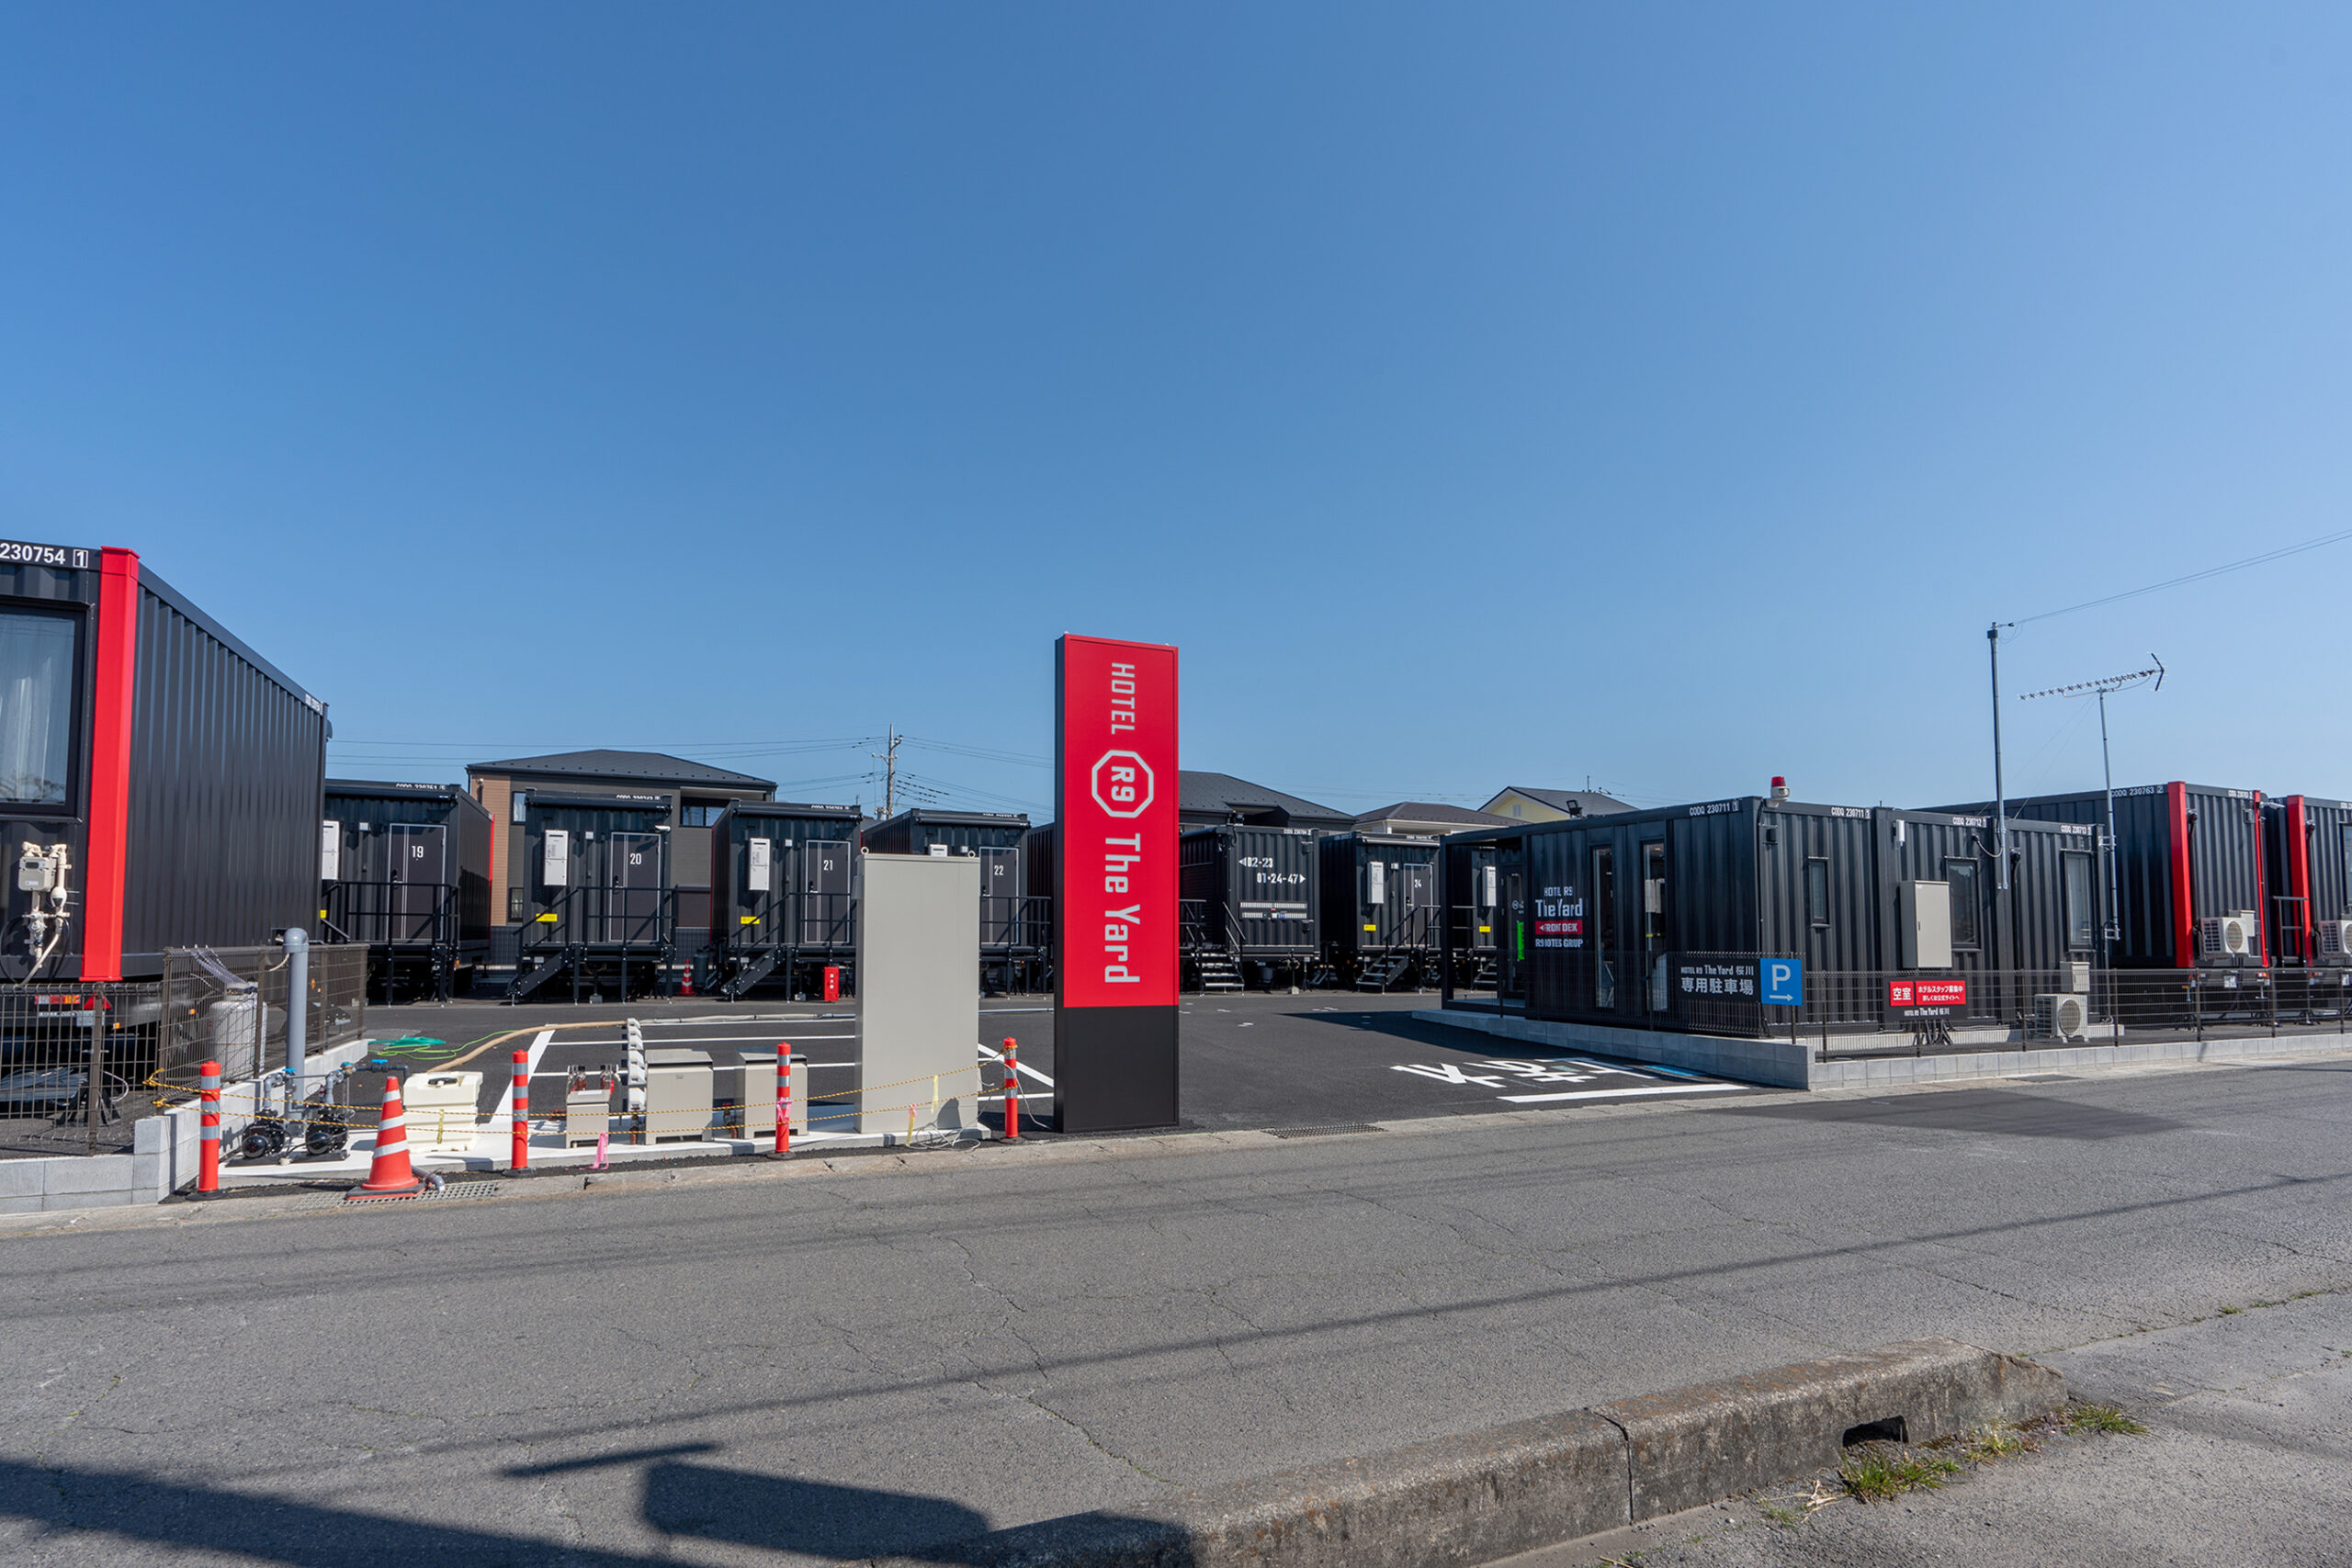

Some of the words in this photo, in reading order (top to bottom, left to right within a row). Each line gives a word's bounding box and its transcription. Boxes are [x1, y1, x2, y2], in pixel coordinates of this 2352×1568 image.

[0, 542, 65, 565] 230754
[74, 549, 88, 568] 1
[1111, 661, 1136, 735] HOTEL
[1111, 765, 1136, 802] R9
[1706, 802, 1730, 814] 230711
[412, 845, 424, 858] 19
[629, 852, 642, 865] 20
[823, 860, 833, 871] 21
[994, 865, 1004, 875] 22
[1104, 832, 1141, 894] The
[1556, 897, 1583, 917] Yard
[1104, 903, 1141, 984] Yard
[1703, 964, 1717, 975] The
[1717, 964, 1734, 976] Yard
[1770, 964, 1792, 991] P
[1680, 976, 1754, 996] 専用駐車場
[1893, 987, 1911, 1000] 空室
